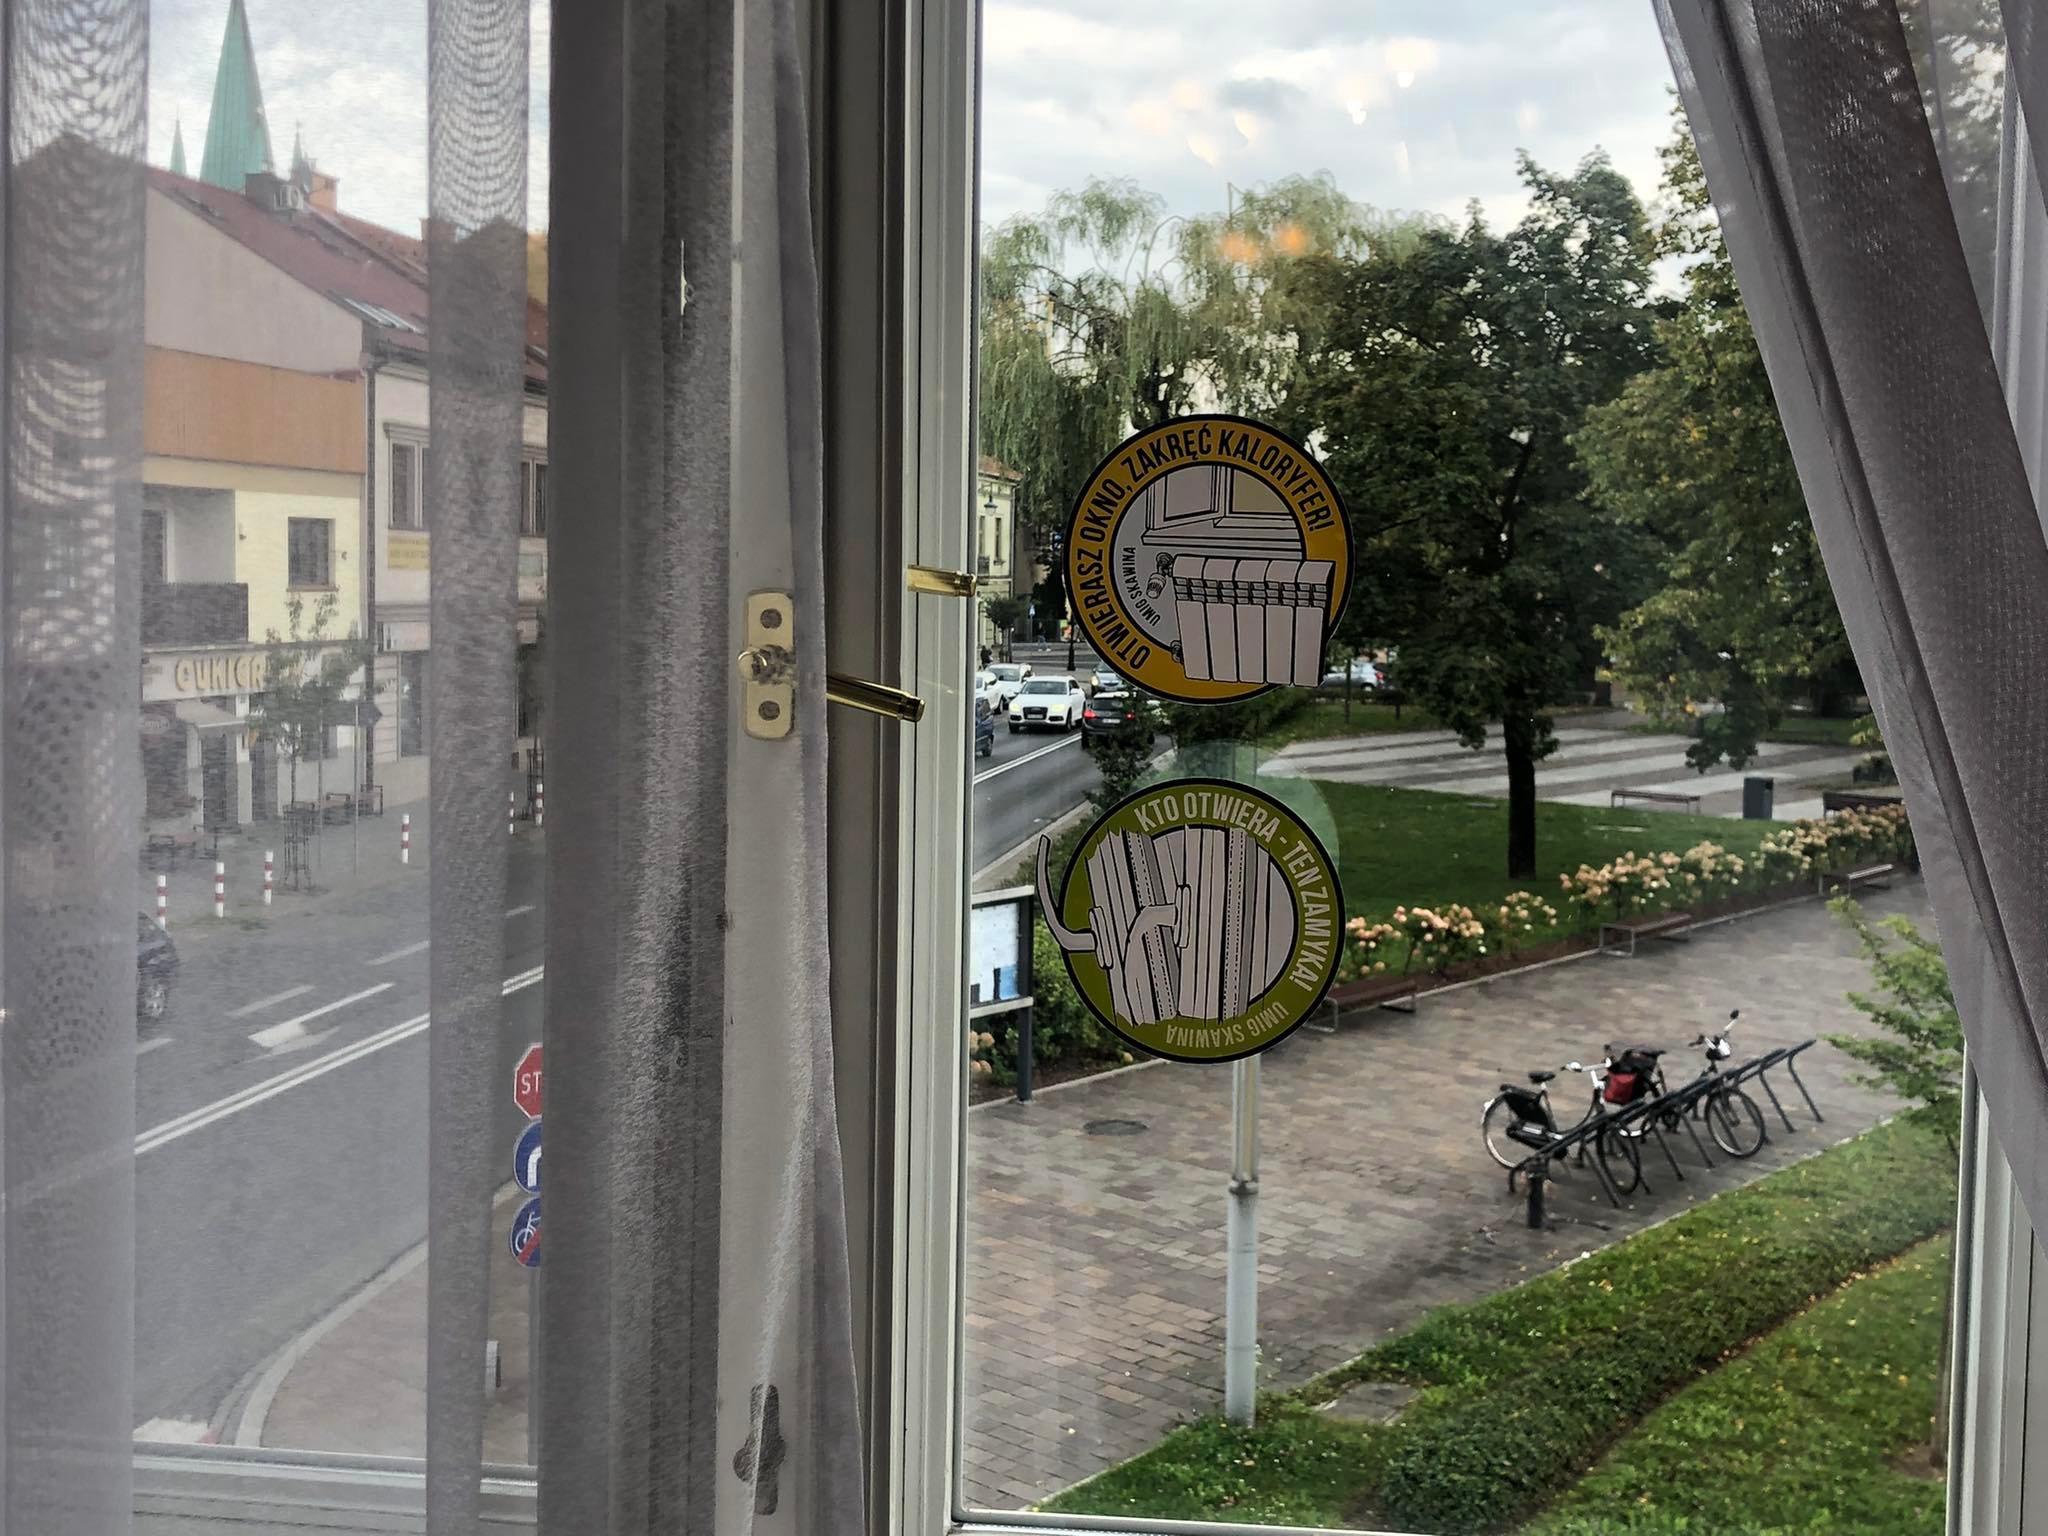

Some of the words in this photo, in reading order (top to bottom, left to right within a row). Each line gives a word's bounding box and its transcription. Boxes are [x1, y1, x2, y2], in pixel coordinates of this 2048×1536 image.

[1120, 423, 1212, 483] ZAKRĘĆ
[1217, 428, 1336, 532] KALORYFER!
[1080, 478, 1133, 544] OKNO,
[1122, 546, 1144, 599] SKAWINA
[1076, 547, 1151, 670] OTWIERASZ
[174, 652, 303, 693] CUKIER
[1134, 794, 1180, 832] KTO
[1184, 791, 1282, 844] OTWIERA
[1282, 840, 1320, 885] TEN
[1289, 885, 1333, 993] ZAMYKA!
[1166, 1023, 1245, 1049] SKAWINA
[521, 1071, 543, 1095] ST
